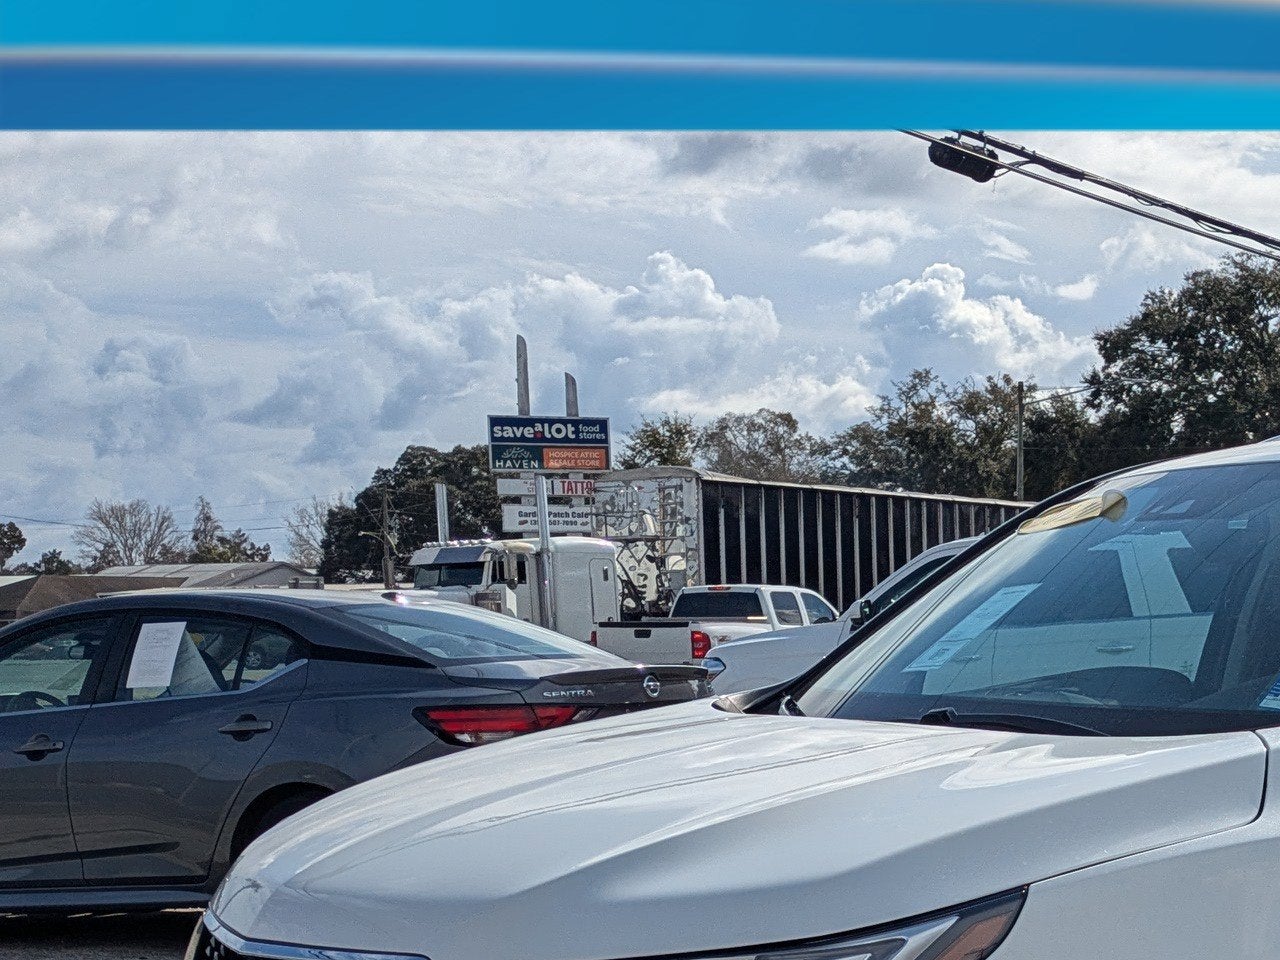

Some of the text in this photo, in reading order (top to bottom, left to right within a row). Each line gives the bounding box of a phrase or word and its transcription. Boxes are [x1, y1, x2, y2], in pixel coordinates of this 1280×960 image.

[579, 424, 600, 432] food
[579, 432, 606, 440] stores
[549, 451, 600, 459] HOSPICE ATTIC
[495, 459, 539, 469] HAVEN
[577, 459, 600, 468] STORE
[560, 480, 595, 495] TATTO
[518, 510, 537, 518] Gard
[548, 510, 570, 518] Patch
